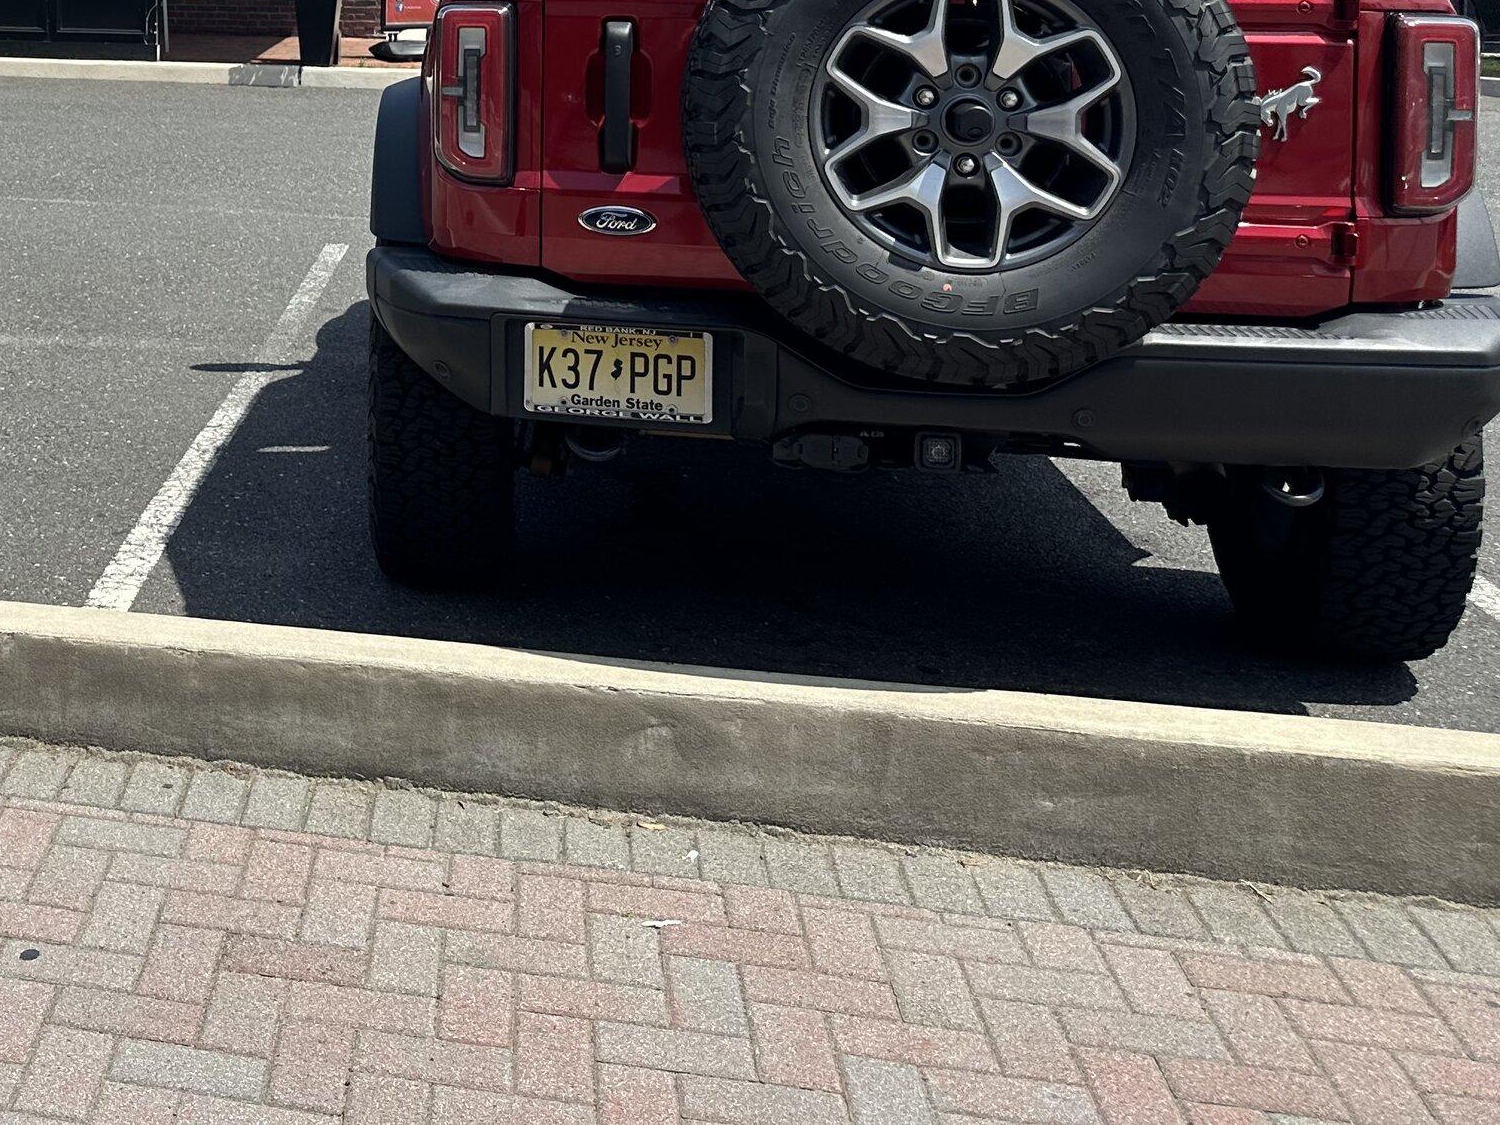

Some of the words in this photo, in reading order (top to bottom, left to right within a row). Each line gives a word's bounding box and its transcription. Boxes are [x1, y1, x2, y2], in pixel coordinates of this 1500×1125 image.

[596, 211, 637, 230] Ford
[772, 136, 1038, 316] BFGoodrich
[571, 331, 609, 345] New
[612, 333, 663, 350] Jersey
[538, 346, 603, 391] K37
[629, 351, 696, 397] PGP
[571, 394, 620, 408] Garden
[626, 397, 663, 411] State
